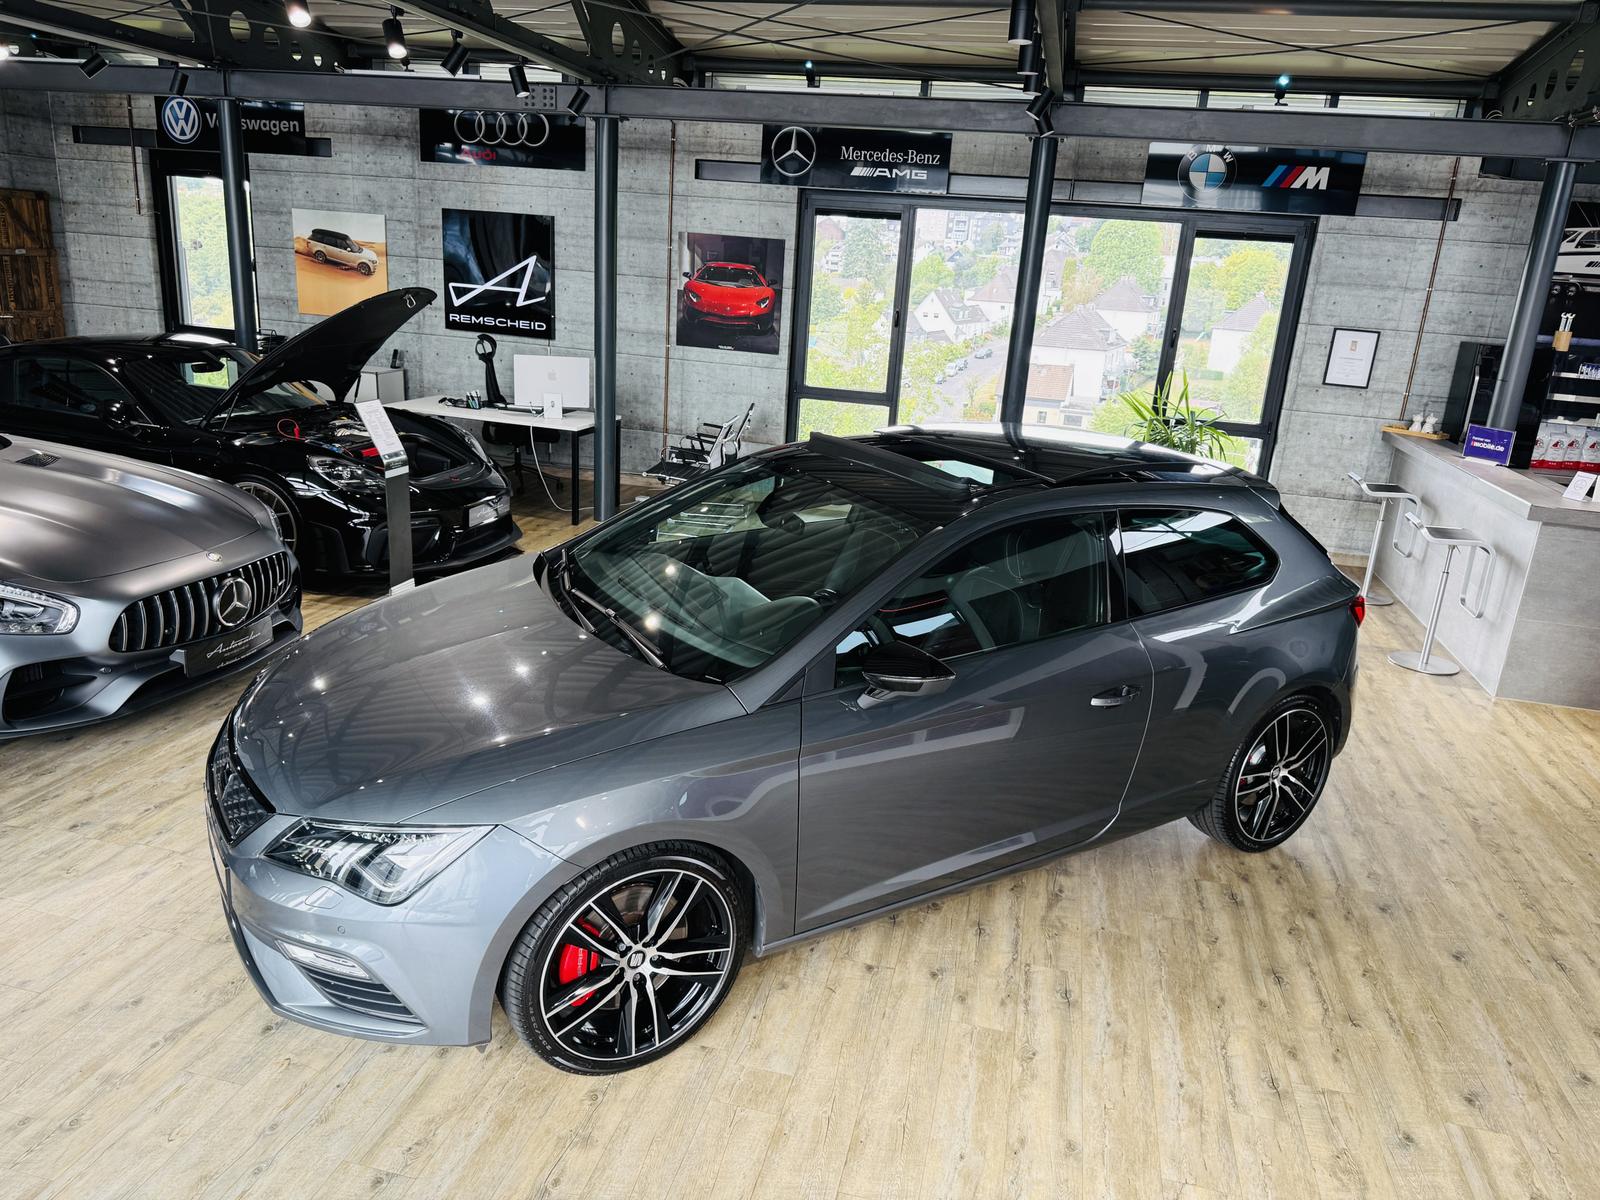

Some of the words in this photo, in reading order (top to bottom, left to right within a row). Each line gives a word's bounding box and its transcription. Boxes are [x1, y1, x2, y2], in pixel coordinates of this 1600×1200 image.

[205, 112, 300, 136] Vswagen
[839, 146, 941, 165] Mercedes-Benz
[872, 167, 928, 180] AMG
[449, 313, 547, 331] REMSCHEID
